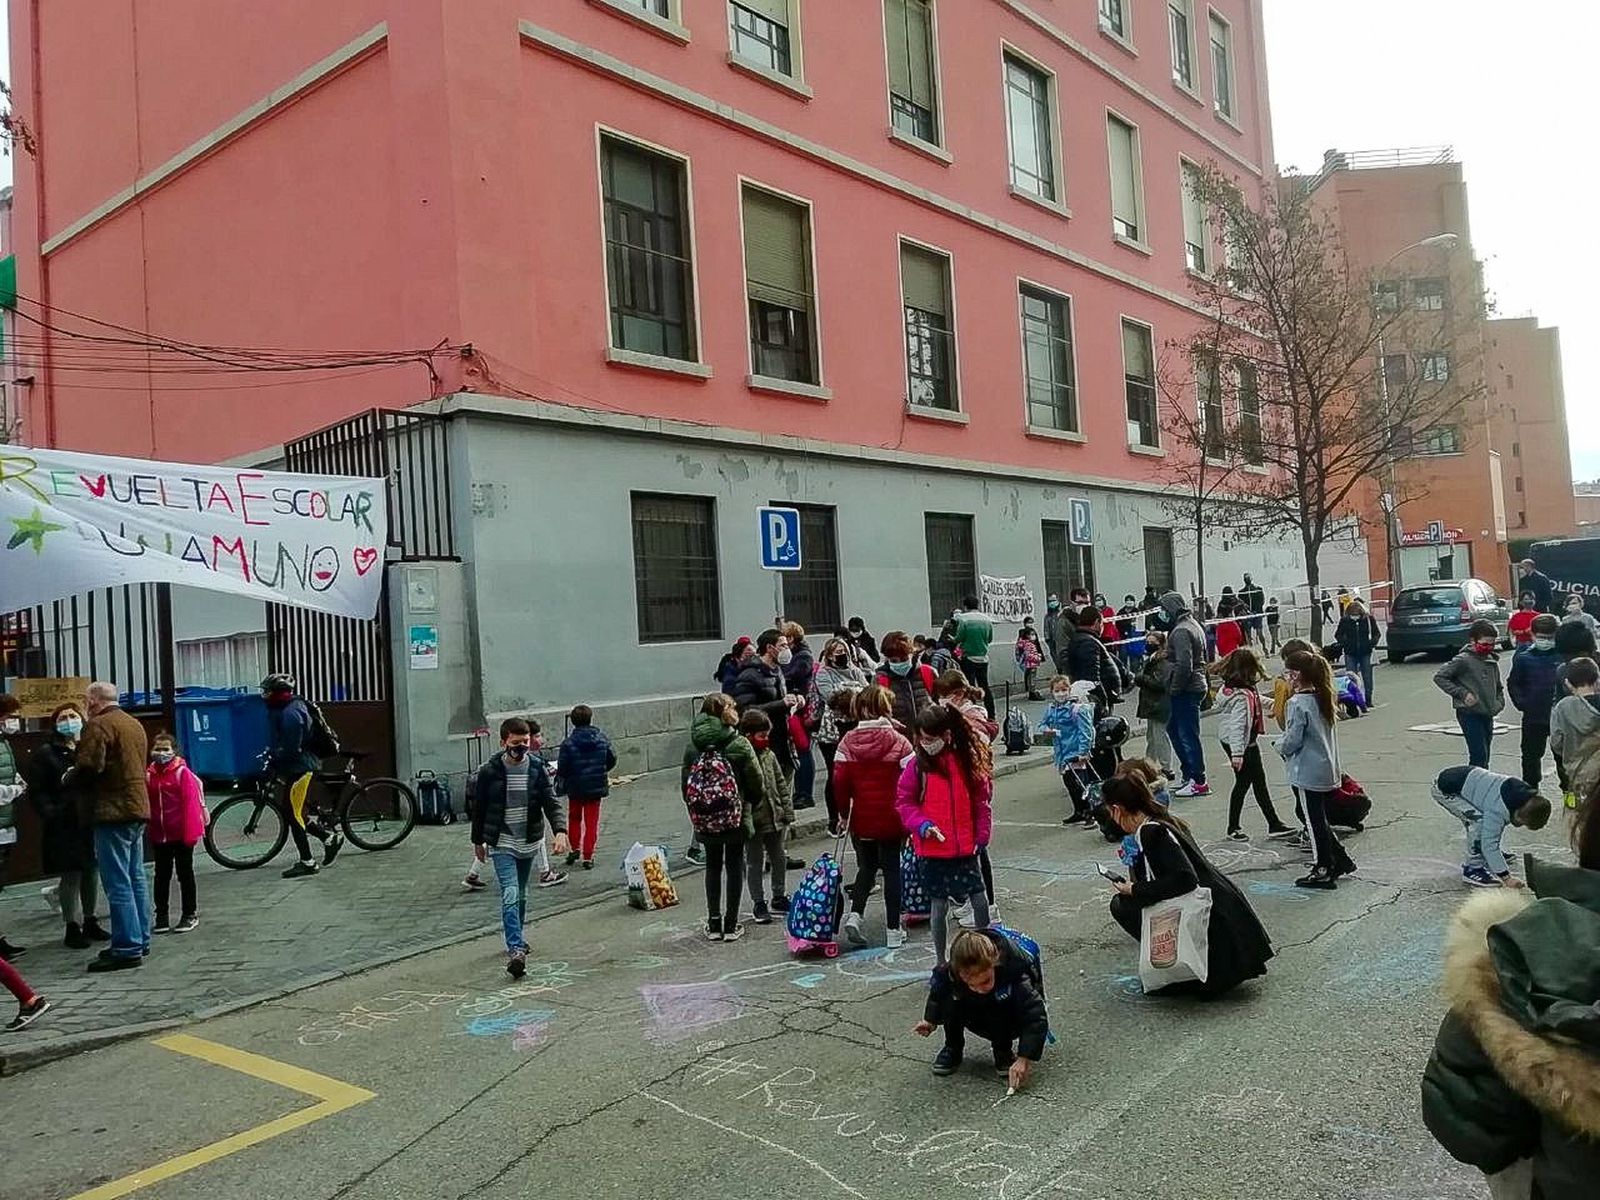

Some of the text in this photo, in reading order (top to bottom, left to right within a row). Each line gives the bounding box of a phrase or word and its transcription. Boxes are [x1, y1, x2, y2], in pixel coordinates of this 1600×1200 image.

[236, 473, 374, 534] ESCOLAR
[1074, 503, 1086, 538] P
[769, 513, 788, 562] P
[1430, 524, 1438, 540] P
[1550, 580, 1600, 597] OLICIA
